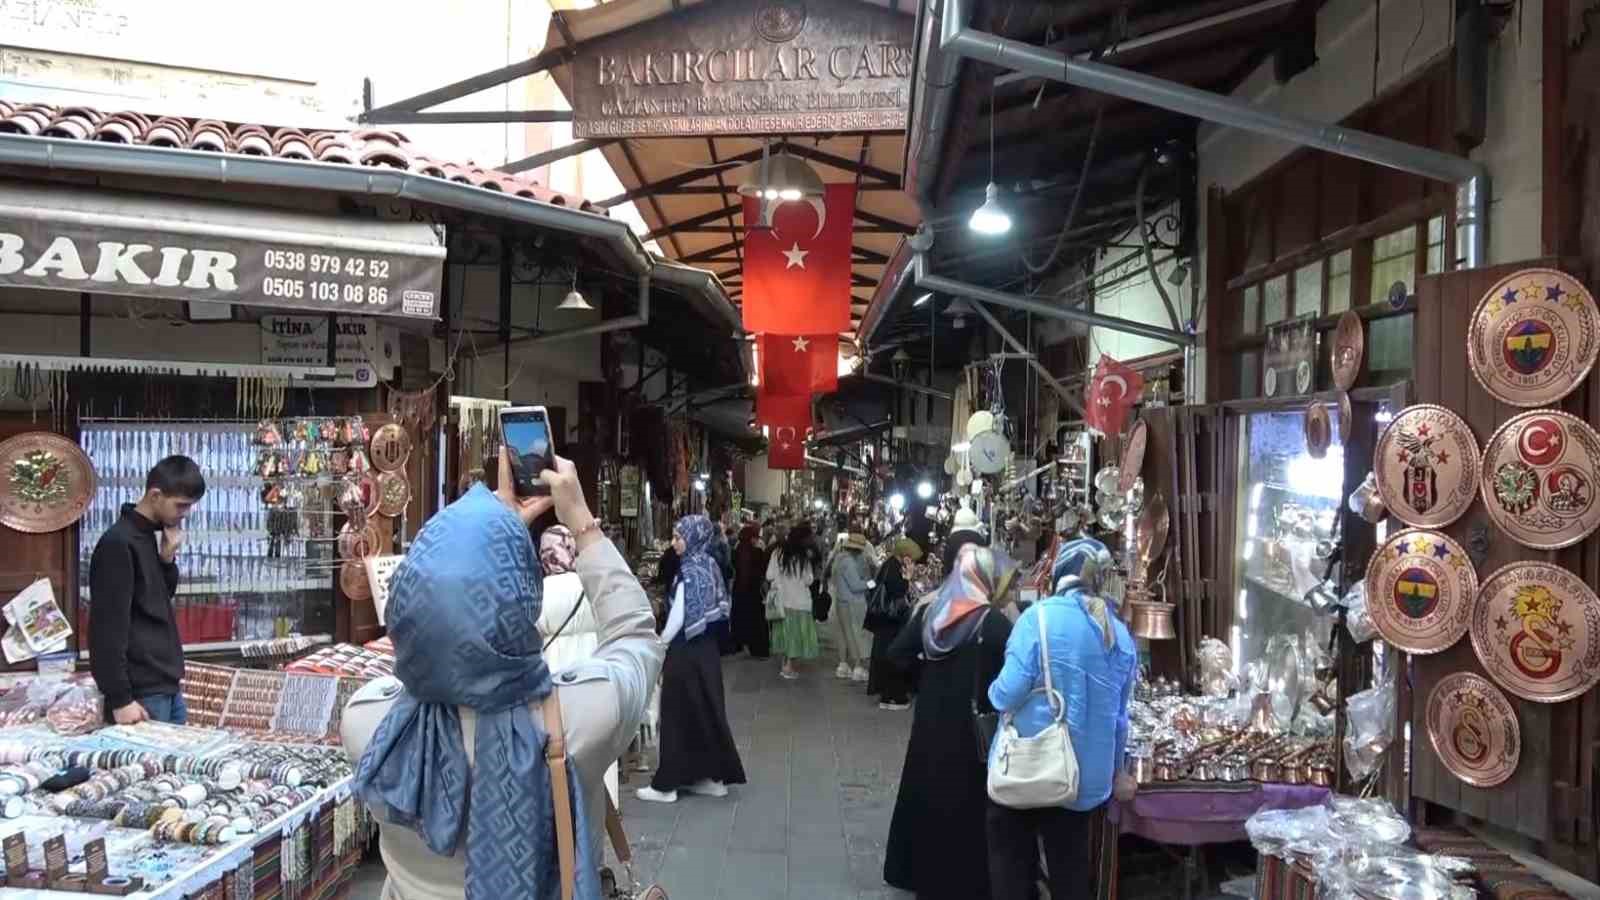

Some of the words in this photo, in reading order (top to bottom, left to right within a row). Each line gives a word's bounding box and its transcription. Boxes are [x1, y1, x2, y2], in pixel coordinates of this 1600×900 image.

[598, 46, 817, 87] BAKIRCILAR
[264, 249, 305, 271] 0538
[310, 254, 340, 274] 979
[344, 258, 365, 276] 42
[369, 260, 389, 278] 52
[263, 277, 304, 298] 0505
[310, 281, 339, 301] 103
[343, 284, 364, 303] 08
[368, 286, 388, 304] 86
